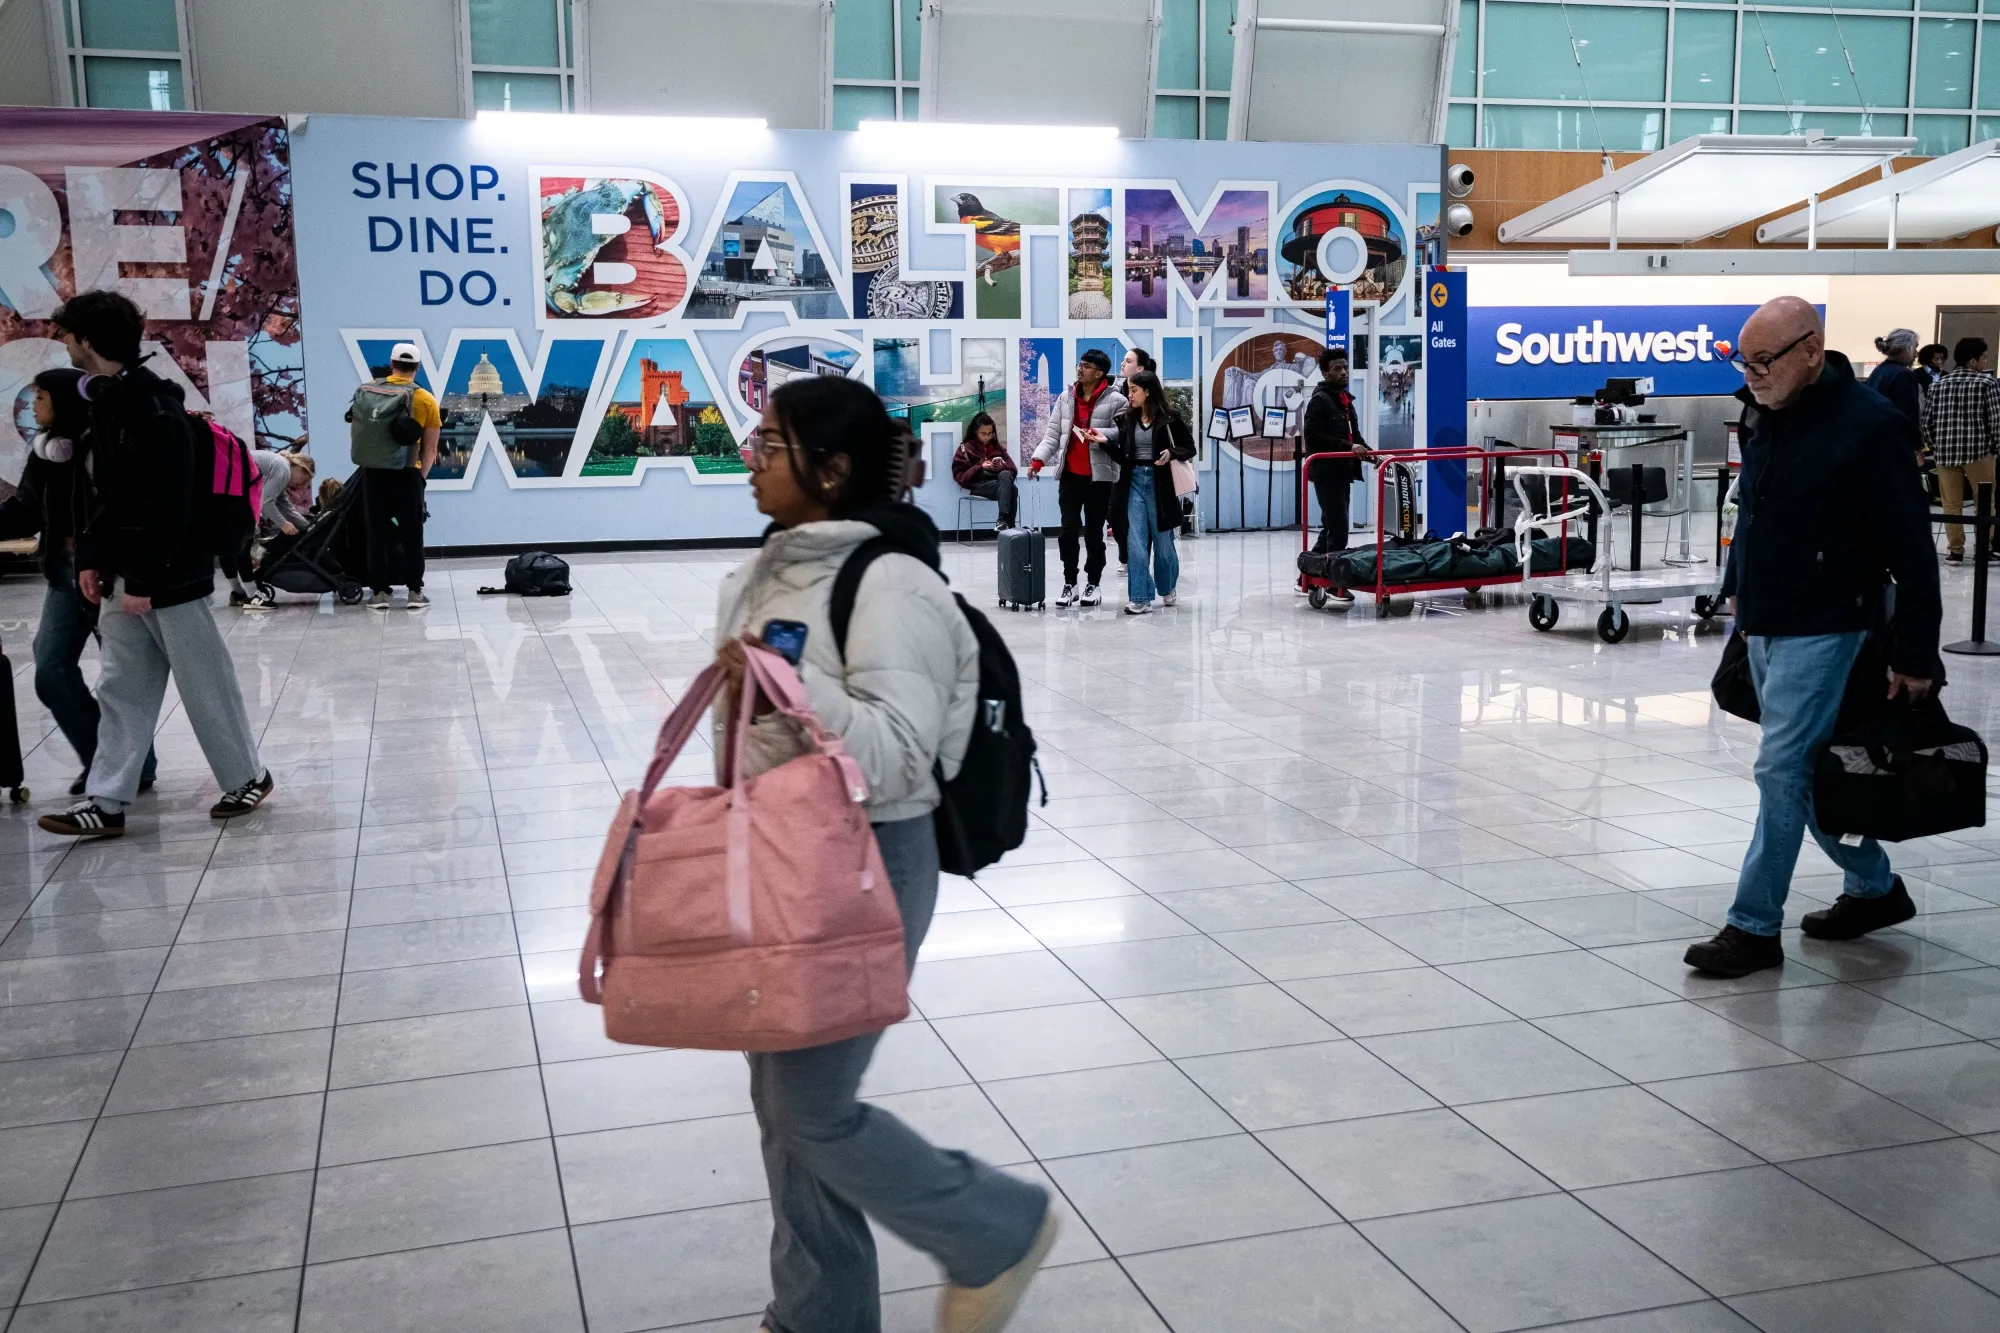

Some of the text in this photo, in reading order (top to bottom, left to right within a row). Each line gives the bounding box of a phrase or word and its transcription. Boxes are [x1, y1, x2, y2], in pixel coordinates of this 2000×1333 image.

[352, 161, 505, 201] SHOP.
[368, 216, 508, 254] DINE.
[528, 165, 1443, 326] BALTIMO
[420, 270, 511, 306] DO.
[1431, 320, 1443, 332] All
[1431, 336, 1456, 348] Gates
[1495, 320, 1713, 364] Southwest
